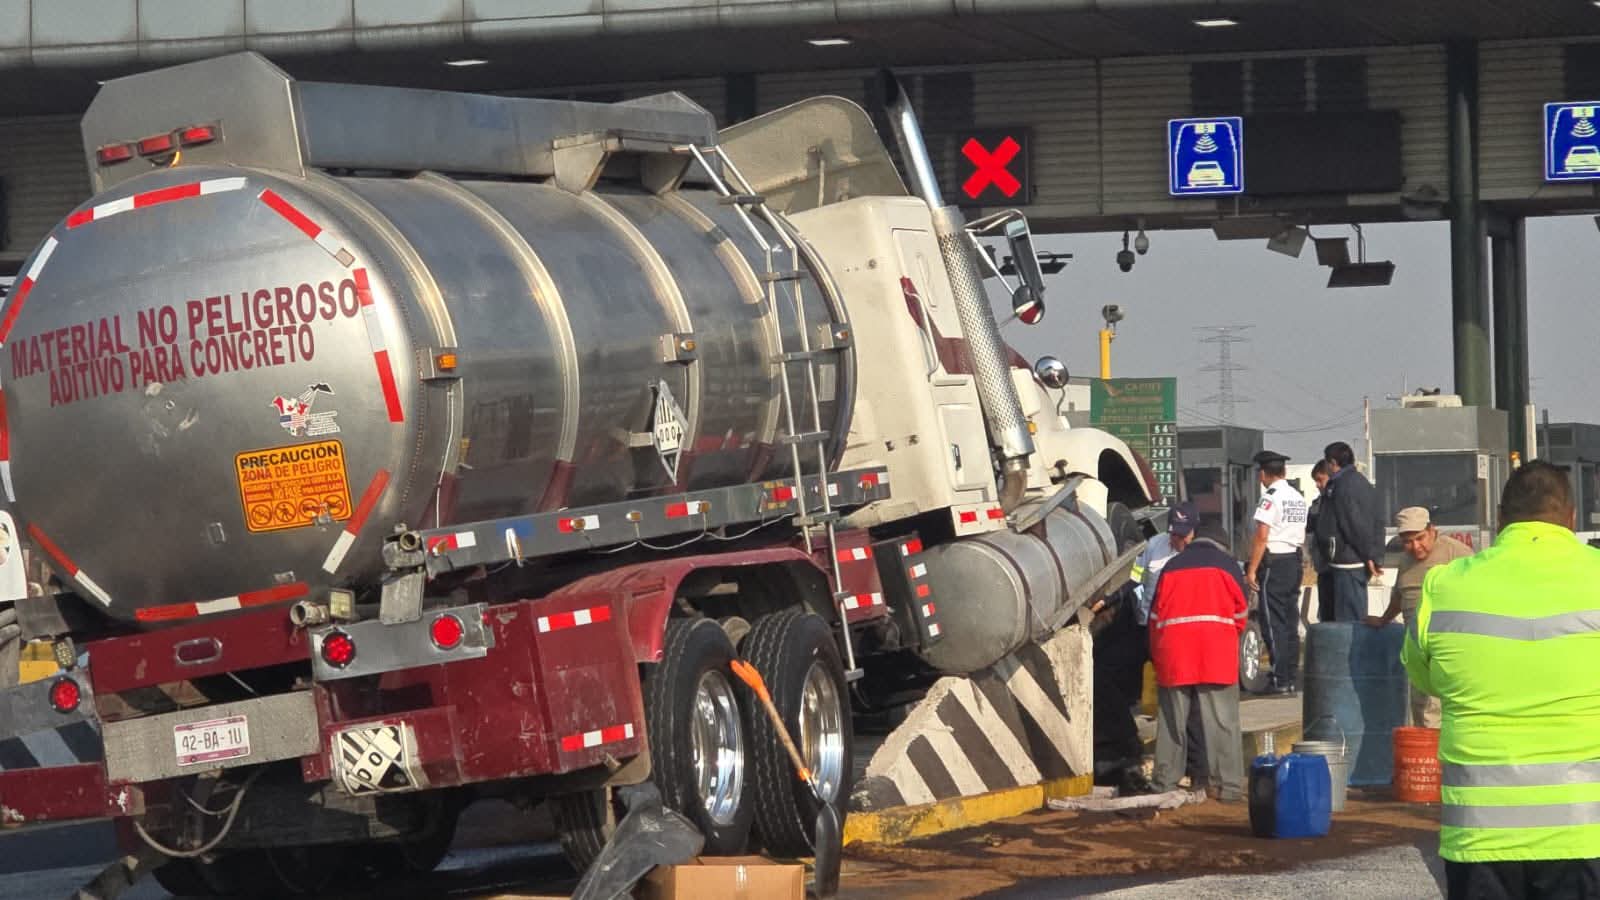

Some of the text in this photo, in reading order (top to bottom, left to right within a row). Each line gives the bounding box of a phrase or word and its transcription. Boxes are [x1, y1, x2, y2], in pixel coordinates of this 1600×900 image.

[12, 278, 359, 380] MATERIAL NO PELIGROSO
[49, 323, 314, 407] ADITIVO PARA CONCRETO
[239, 444, 339, 470] PRECAUCIÓN
[241, 458, 340, 482] ZONA DE PELIGRO
[182, 727, 242, 752] 42-BA-1U
